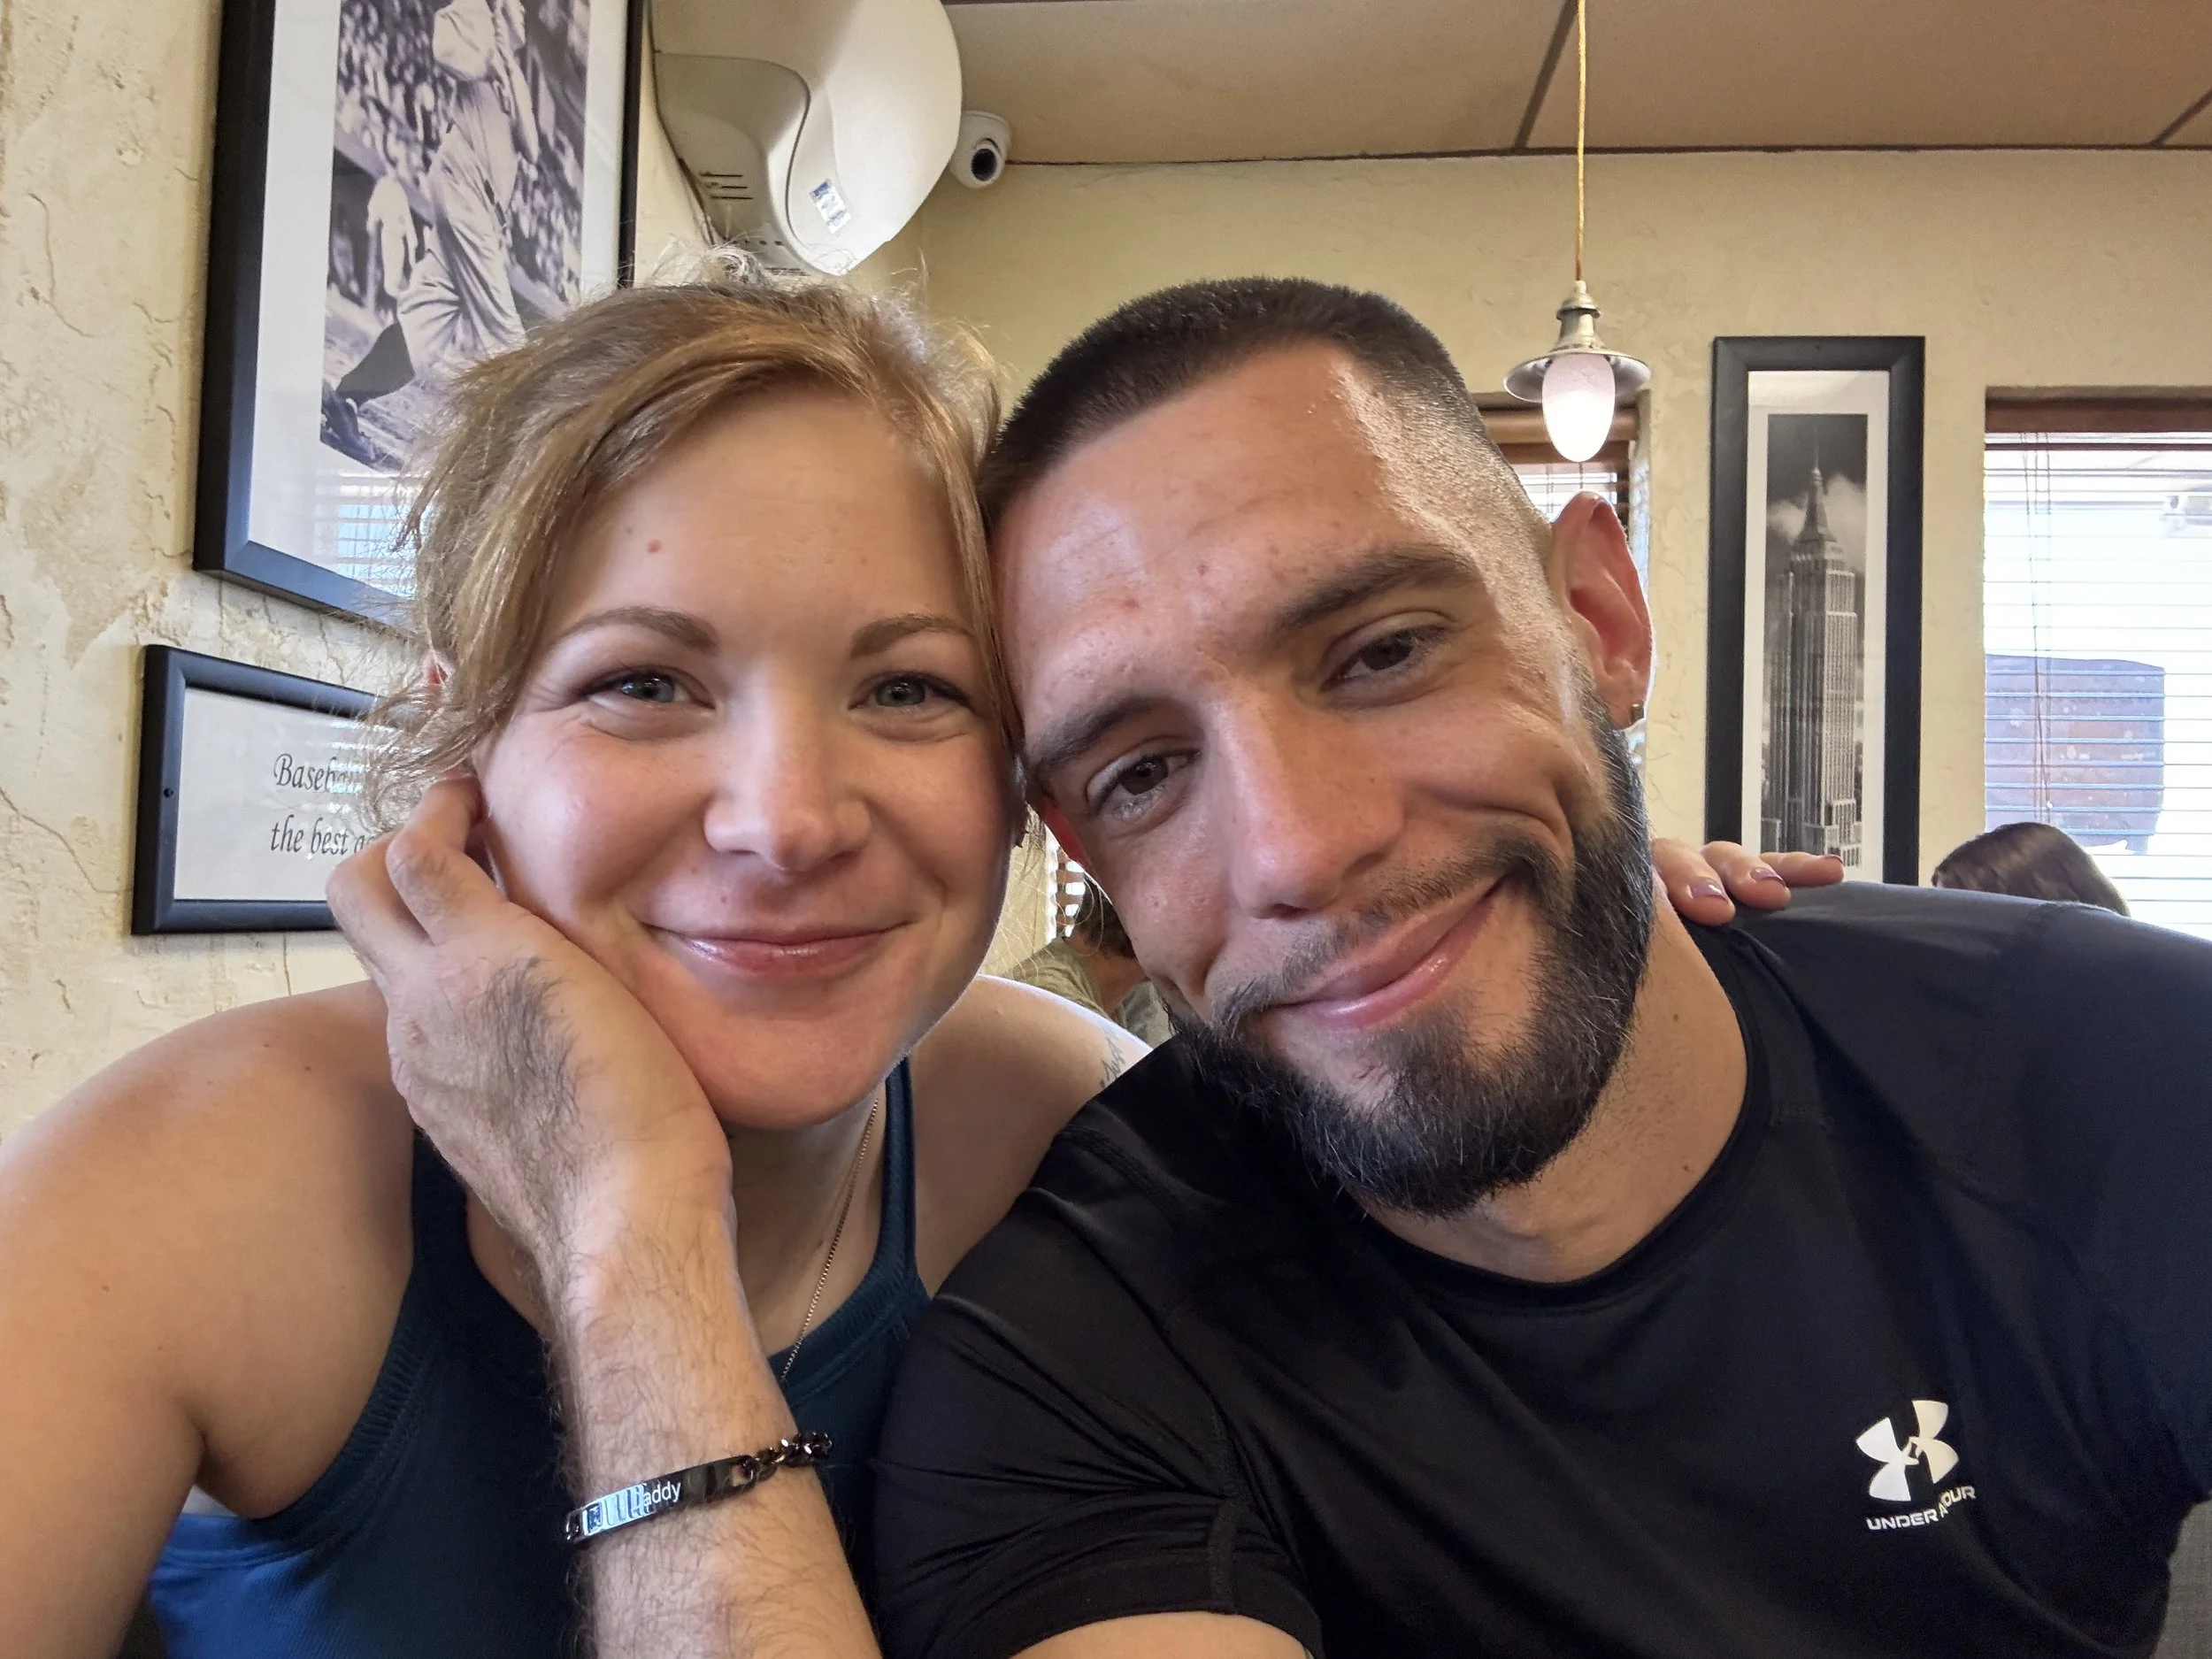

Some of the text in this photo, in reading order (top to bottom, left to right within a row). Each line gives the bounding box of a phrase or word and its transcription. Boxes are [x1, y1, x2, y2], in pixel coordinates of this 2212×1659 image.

[271, 814, 304, 853] the
[311, 817, 349, 856] best
[634, 1480, 681, 1507] addy
[1866, 1508, 1939, 1530] UNDER
